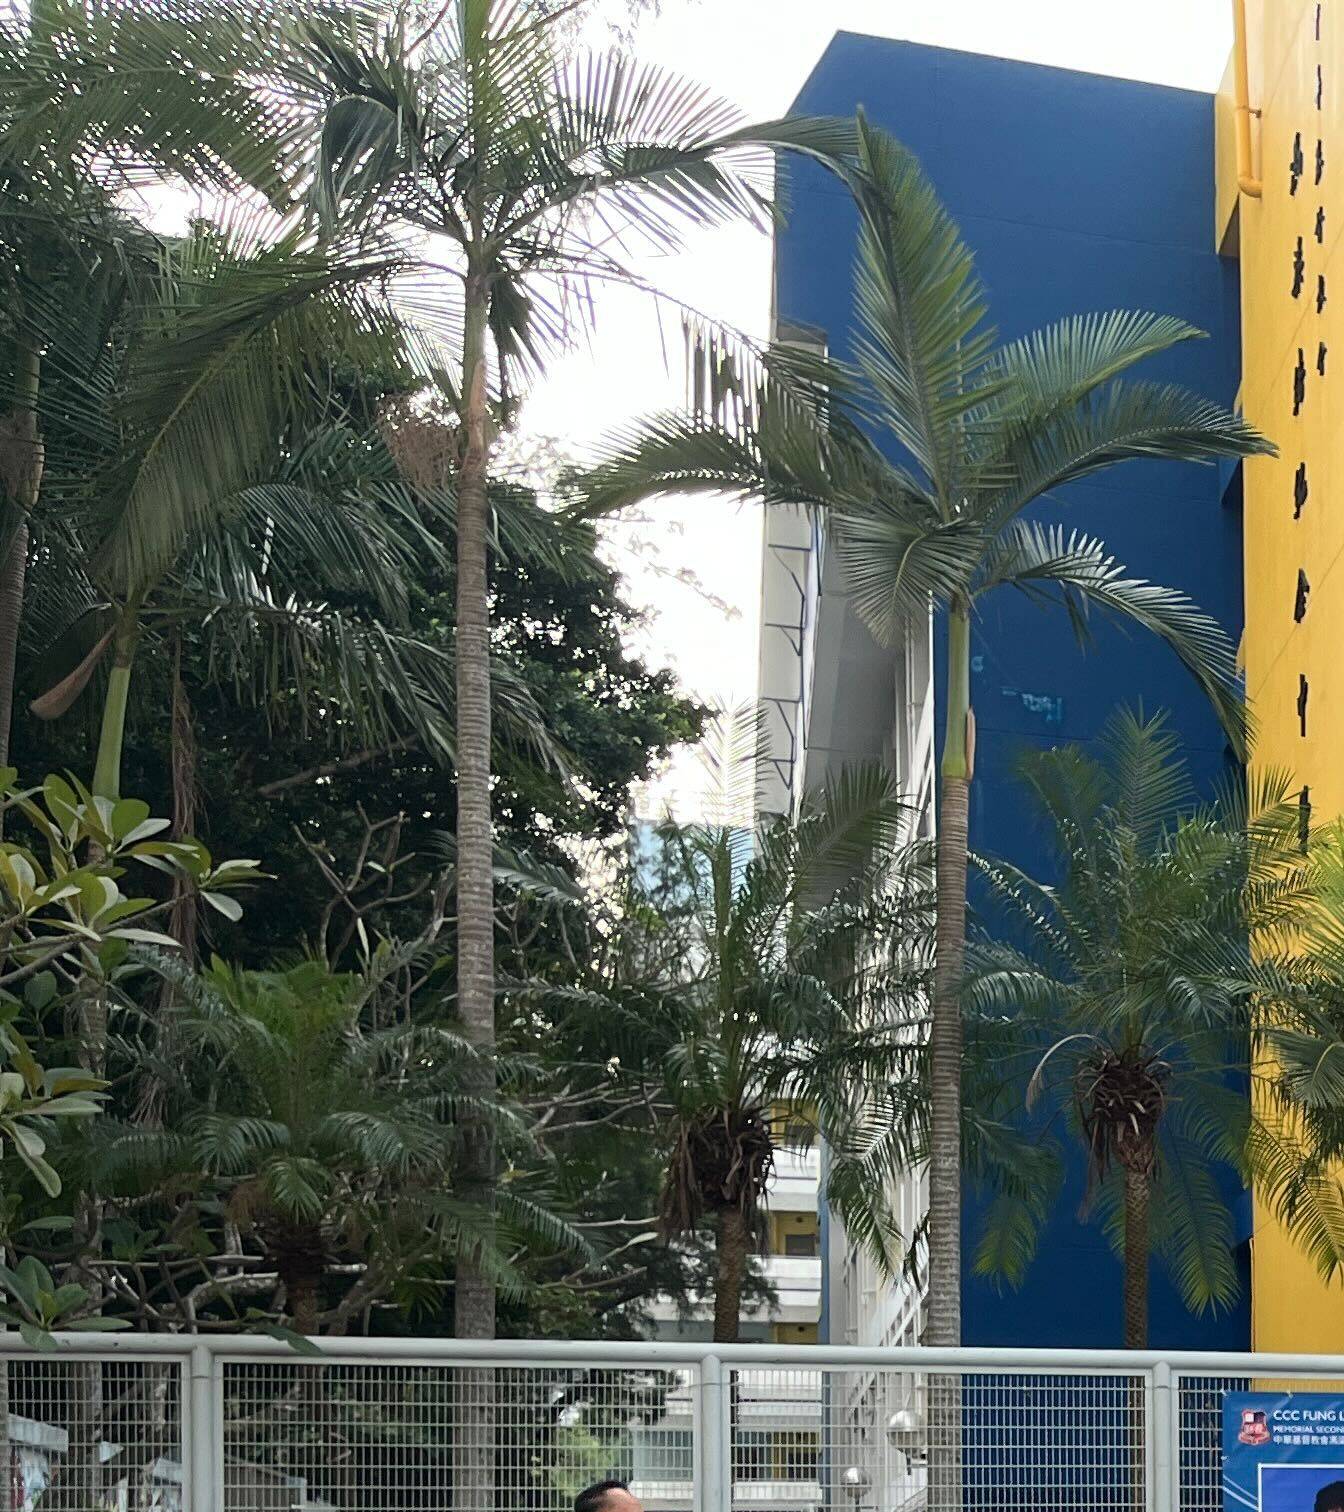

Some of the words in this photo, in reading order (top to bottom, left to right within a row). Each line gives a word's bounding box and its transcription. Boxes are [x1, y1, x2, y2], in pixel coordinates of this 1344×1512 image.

[1273, 1410, 1300, 1421] CCC
[1303, 1410, 1337, 1421] FUNG
[1273, 1425, 1314, 1434] MEMORIAL
